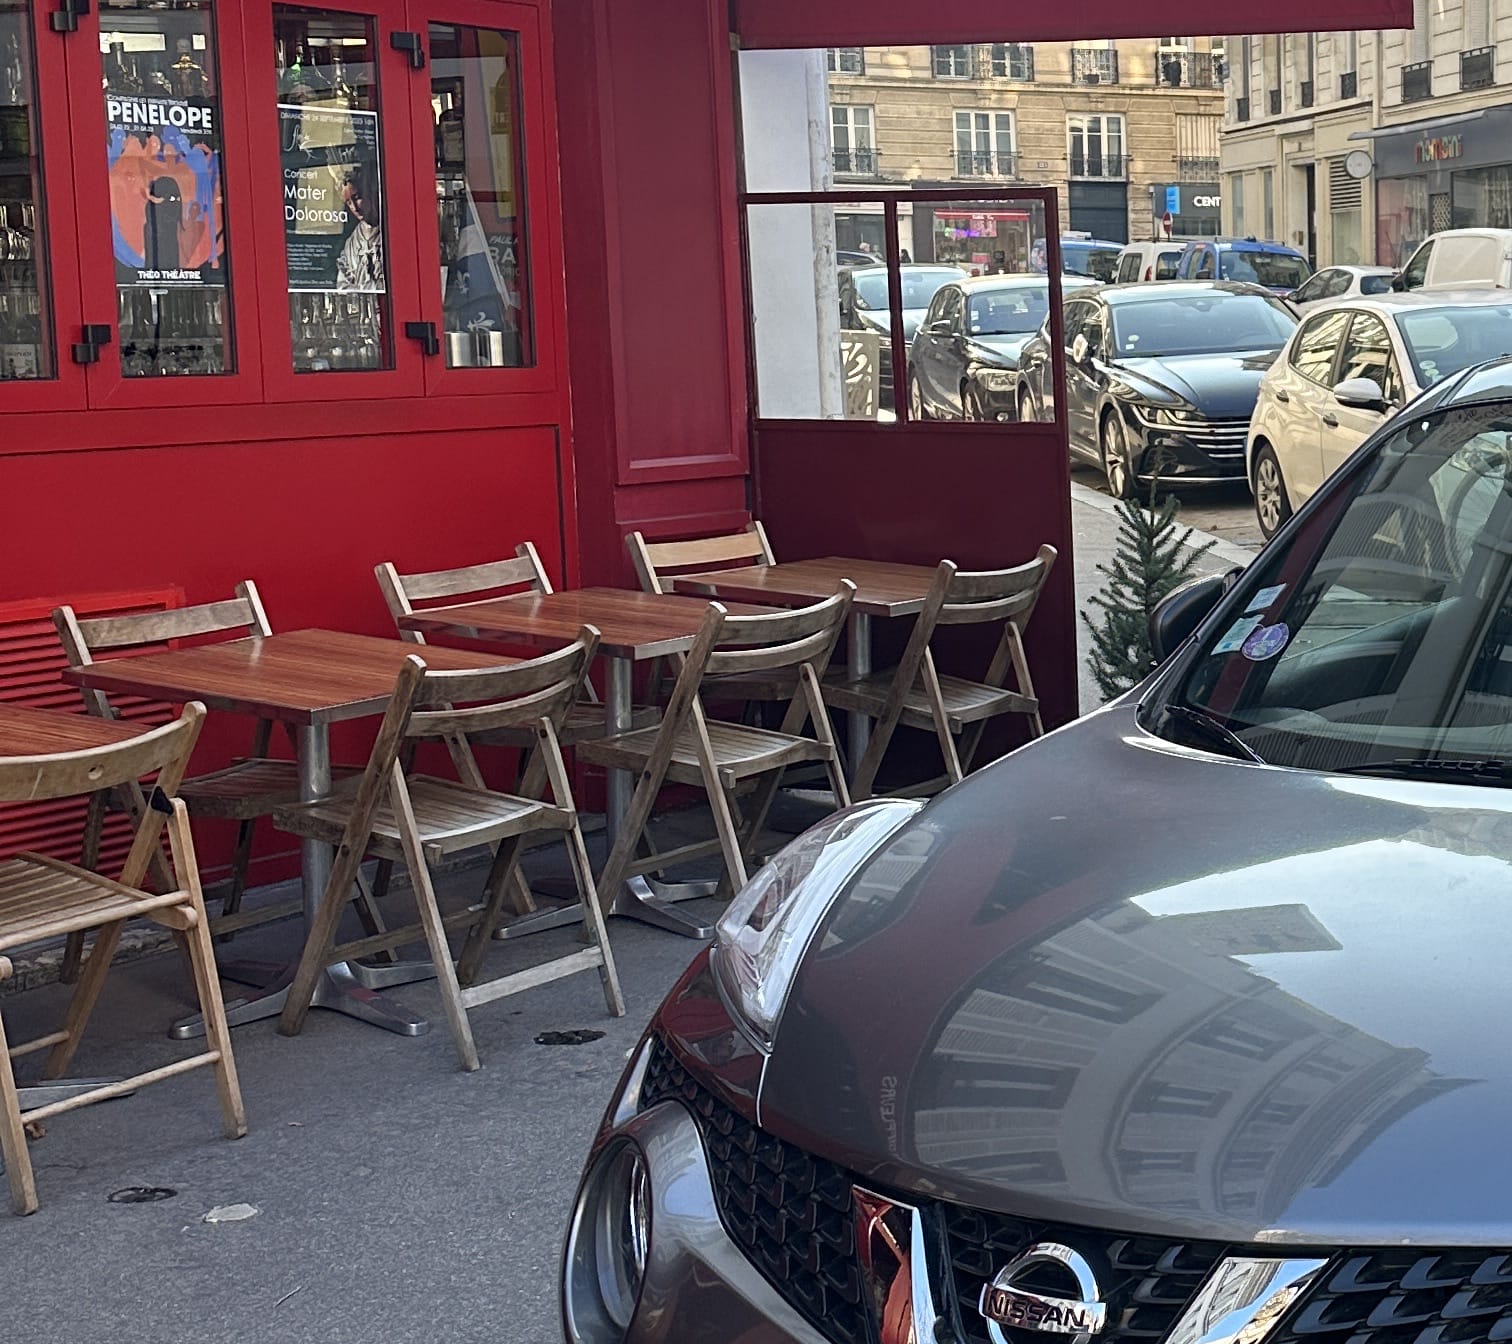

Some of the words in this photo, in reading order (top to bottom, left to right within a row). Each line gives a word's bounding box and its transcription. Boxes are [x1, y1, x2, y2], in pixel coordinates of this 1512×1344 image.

[106, 100, 213, 129] PENELOPE
[284, 168, 318, 179] Concert
[284, 184, 327, 201] Mater
[284, 205, 349, 223] Dolorosa
[986, 1290, 1087, 1327] NISSAN
